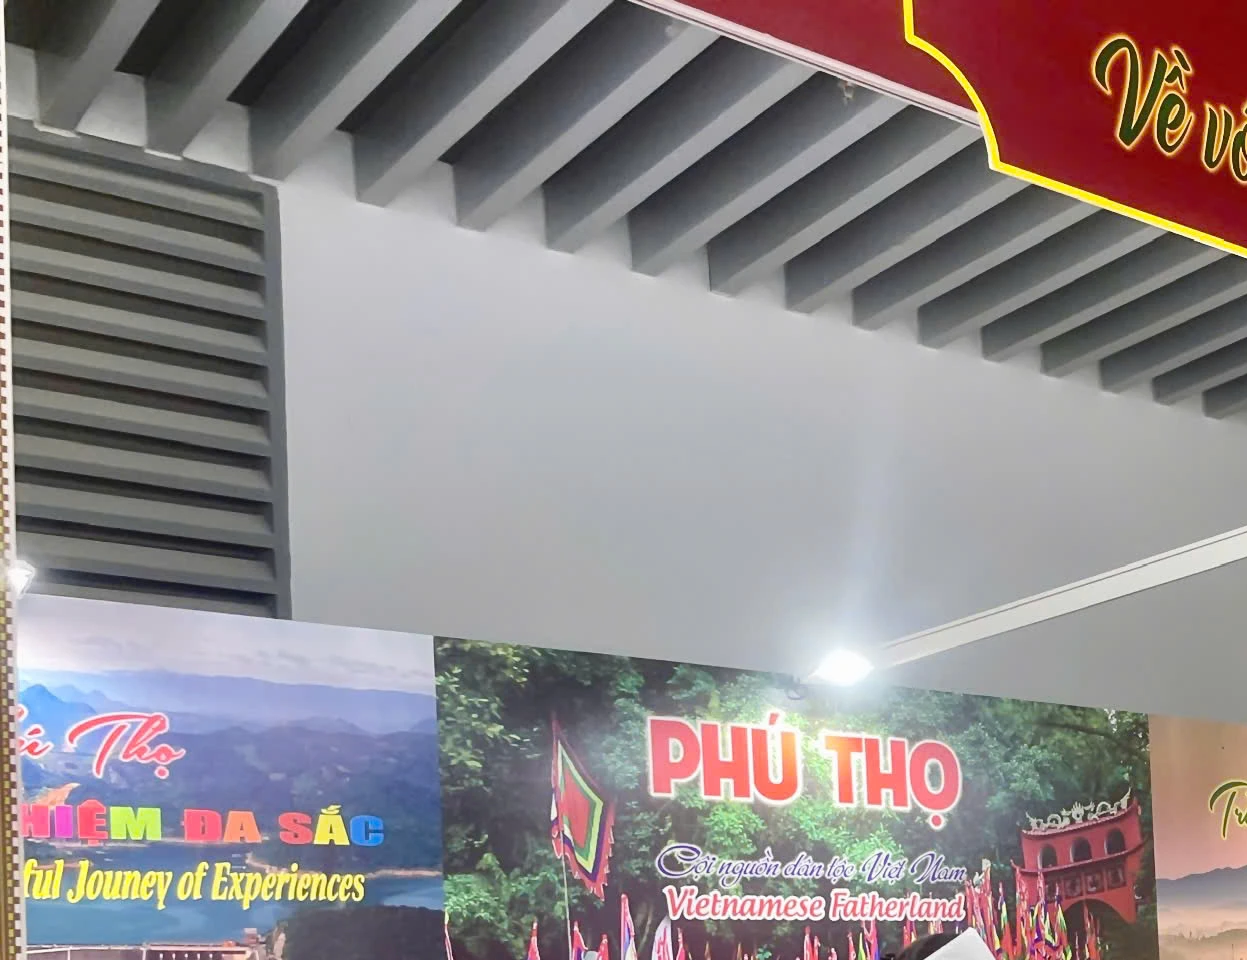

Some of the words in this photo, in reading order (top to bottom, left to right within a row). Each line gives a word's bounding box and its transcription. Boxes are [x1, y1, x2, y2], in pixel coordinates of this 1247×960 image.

[1095, 35, 1191, 150] Về
[66, 712, 186, 779] Thọ
[648, 711, 799, 804] PHÚ
[823, 730, 962, 831] THỌ
[181, 808, 262, 845] ĐA
[278, 804, 385, 847] SẮC
[67, 861, 171, 910] Jouney
[177, 862, 209, 901] of
[211, 861, 366, 910] Experiences
[656, 843, 717, 881] Cội
[718, 846, 781, 888] nguồn
[783, 851, 823, 878] dân
[825, 855, 856, 884] tộc
[861, 850, 909, 885] Việt
[910, 850, 967, 884] Nam
[664, 886, 825, 920] Vietnamese
[830, 888, 965, 921] Fatherland
